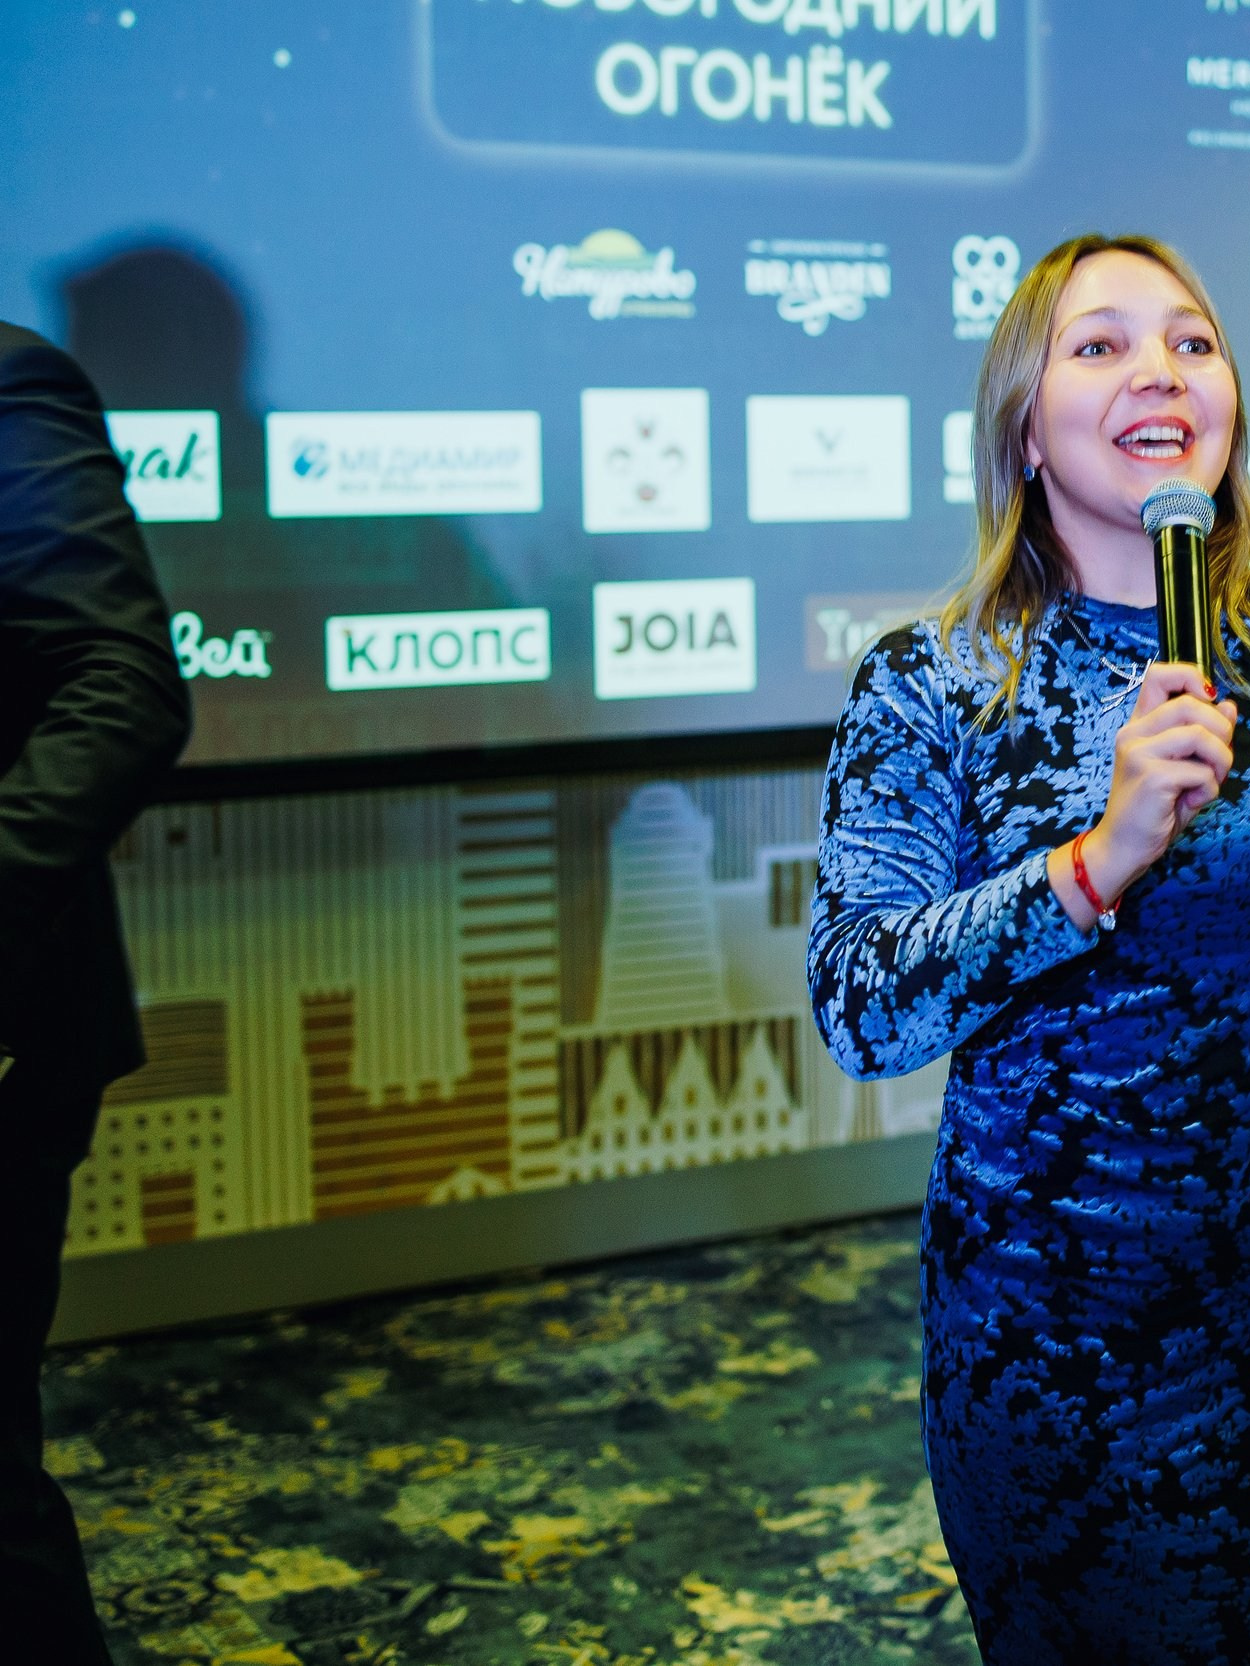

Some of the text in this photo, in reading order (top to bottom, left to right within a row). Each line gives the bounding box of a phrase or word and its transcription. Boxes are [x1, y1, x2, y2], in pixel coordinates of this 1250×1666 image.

[595, 42, 894, 130] ОГОНЁК
[345, 626, 540, 674] КЛОПС
[612, 610, 738, 654] JOIA
